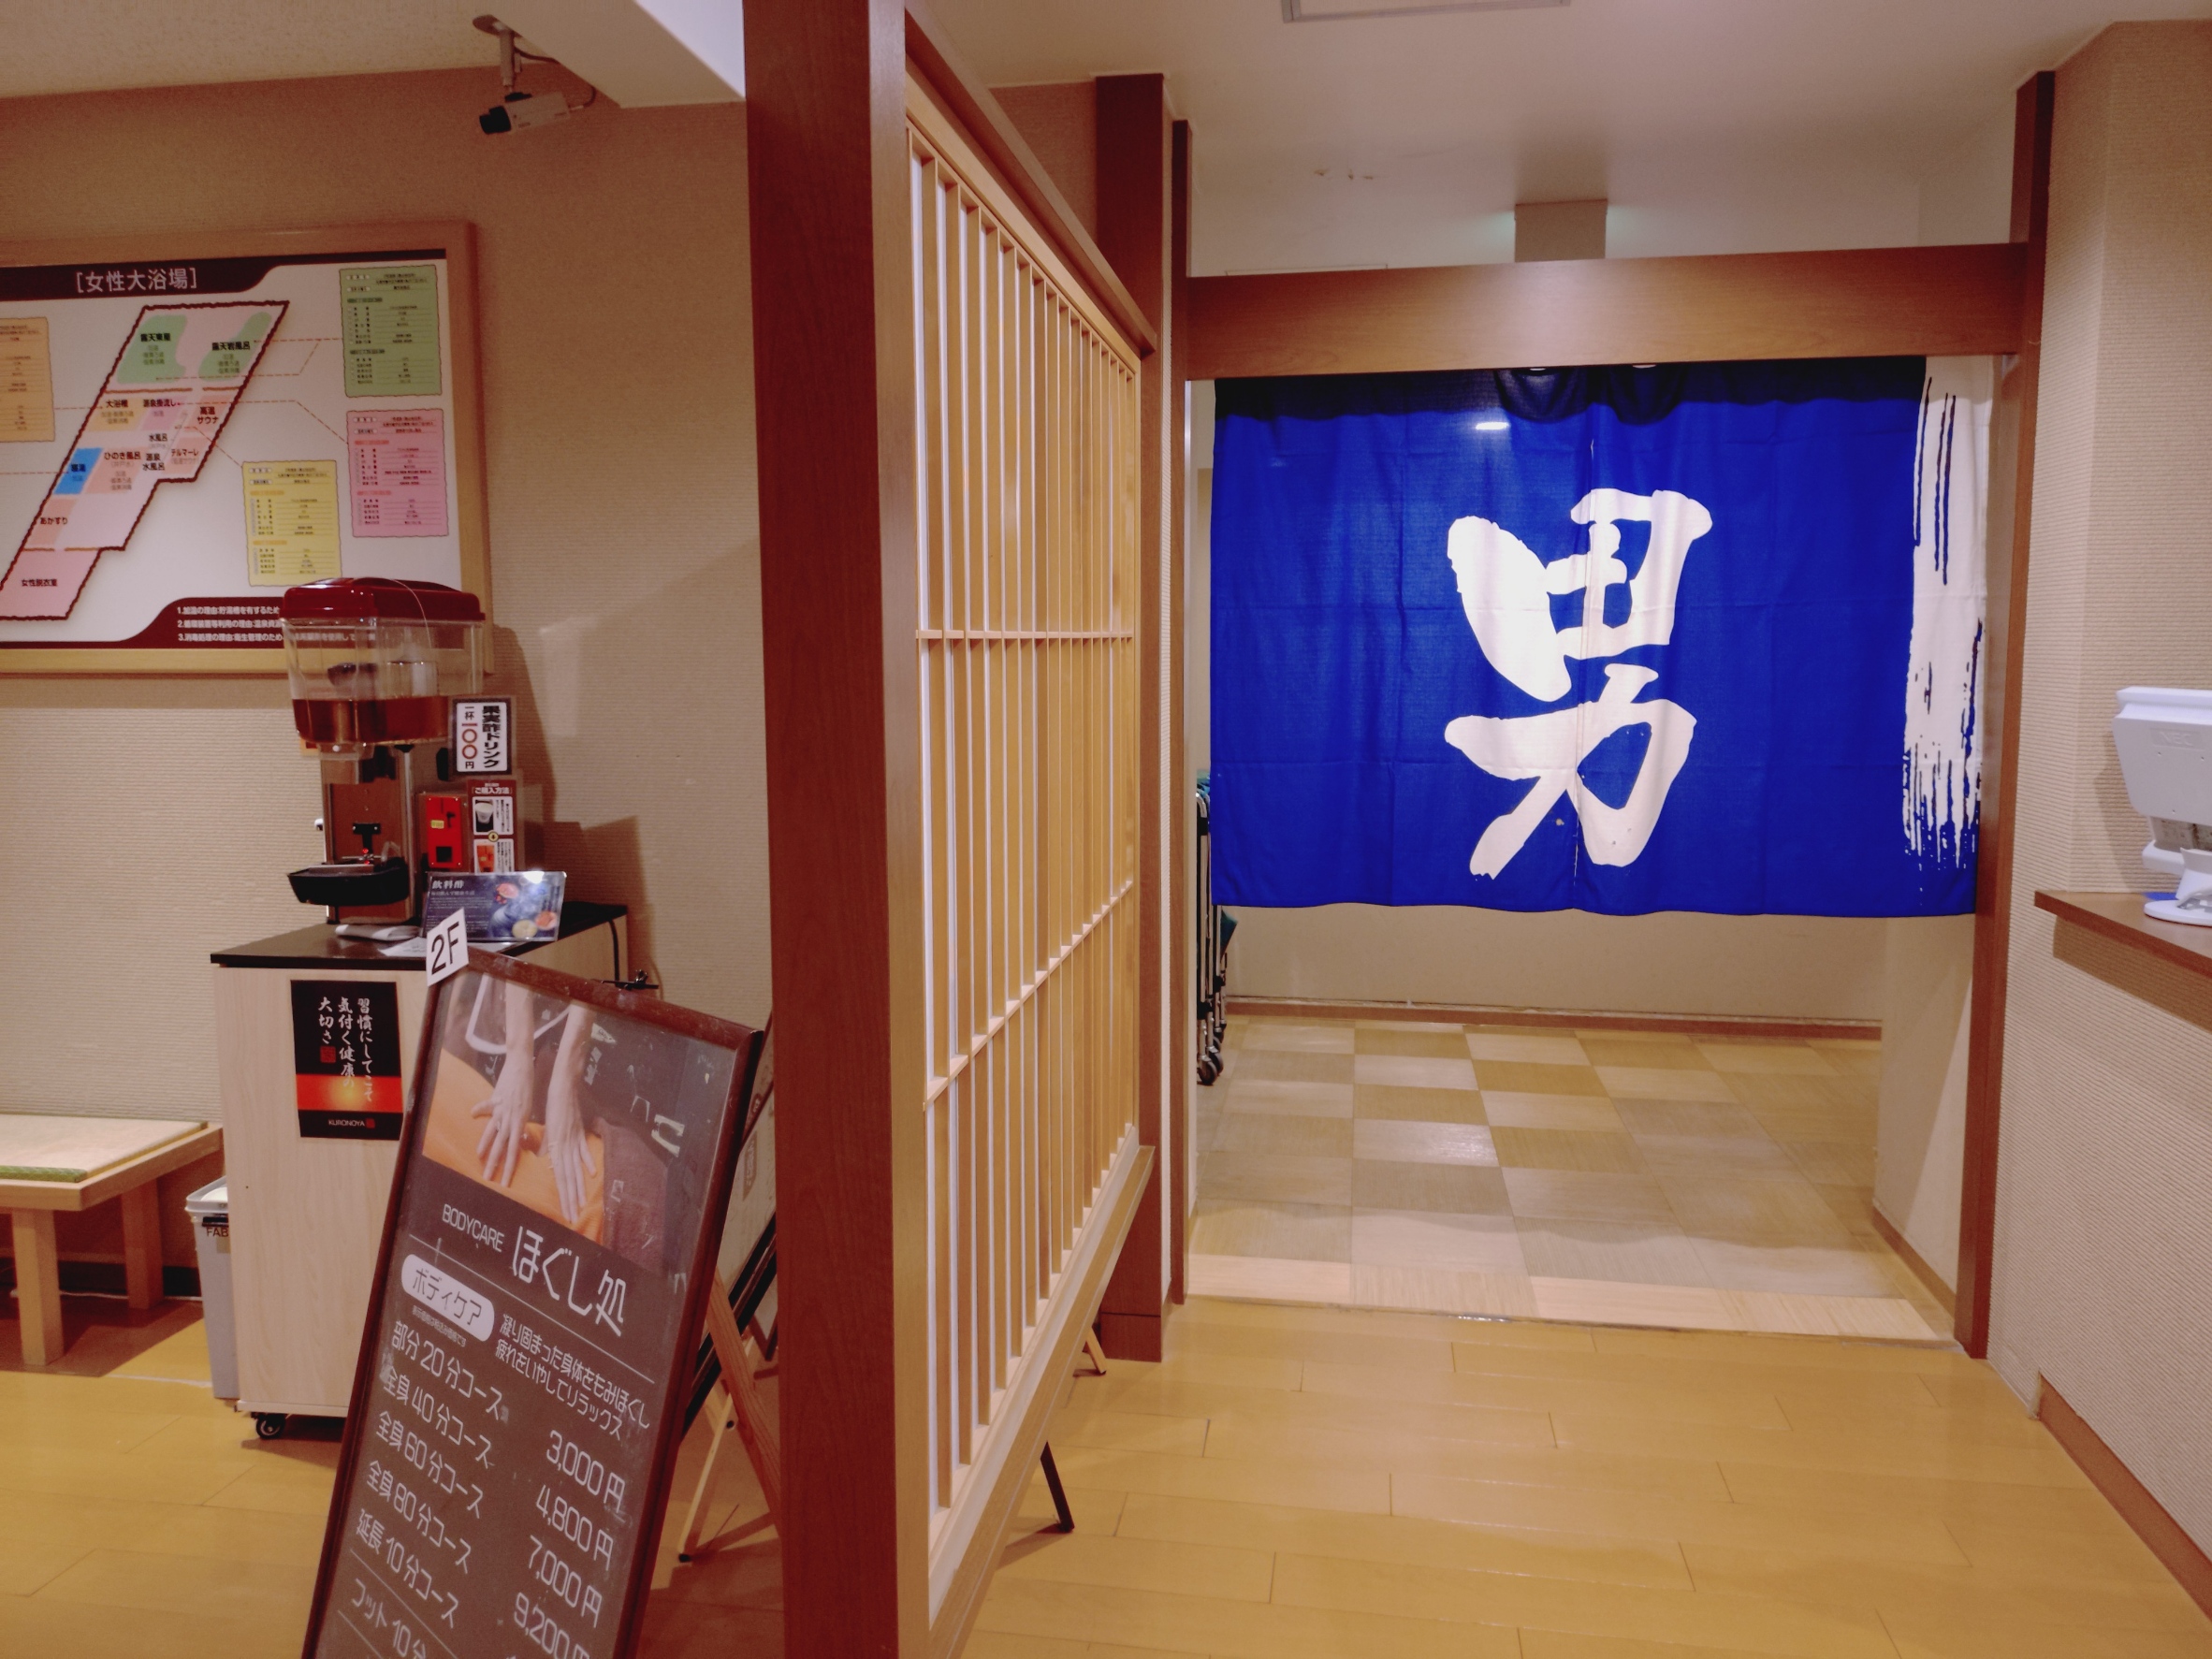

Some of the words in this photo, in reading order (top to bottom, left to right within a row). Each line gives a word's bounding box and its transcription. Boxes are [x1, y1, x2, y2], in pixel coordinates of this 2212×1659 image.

[104, 450, 141, 460] ひのき風呂
[196, 415, 219, 425] サウナ
[39, 517, 68, 526] あかすり
[1444, 488, 1713, 880] 男
[482, 705, 502, 768] 果実酢ドリンク
[430, 921, 459, 975] 2F
[318, 996, 335, 1045] 大切さ
[338, 996, 357, 1087] 気付く健康の
[357, 997, 373, 1102] 習慣にしてこそ
[442, 1203, 504, 1253] BODYCARE
[412, 1268, 483, 1326] ボディケア
[511, 1225, 627, 1337] ほぐし処
[495, 1338, 621, 1441] 疲れをいやしてリラックス
[546, 1429, 626, 1514] 3,000円
[535, 1484, 614, 1571] 4,800円
[528, 1534, 603, 1628] 7,000円
